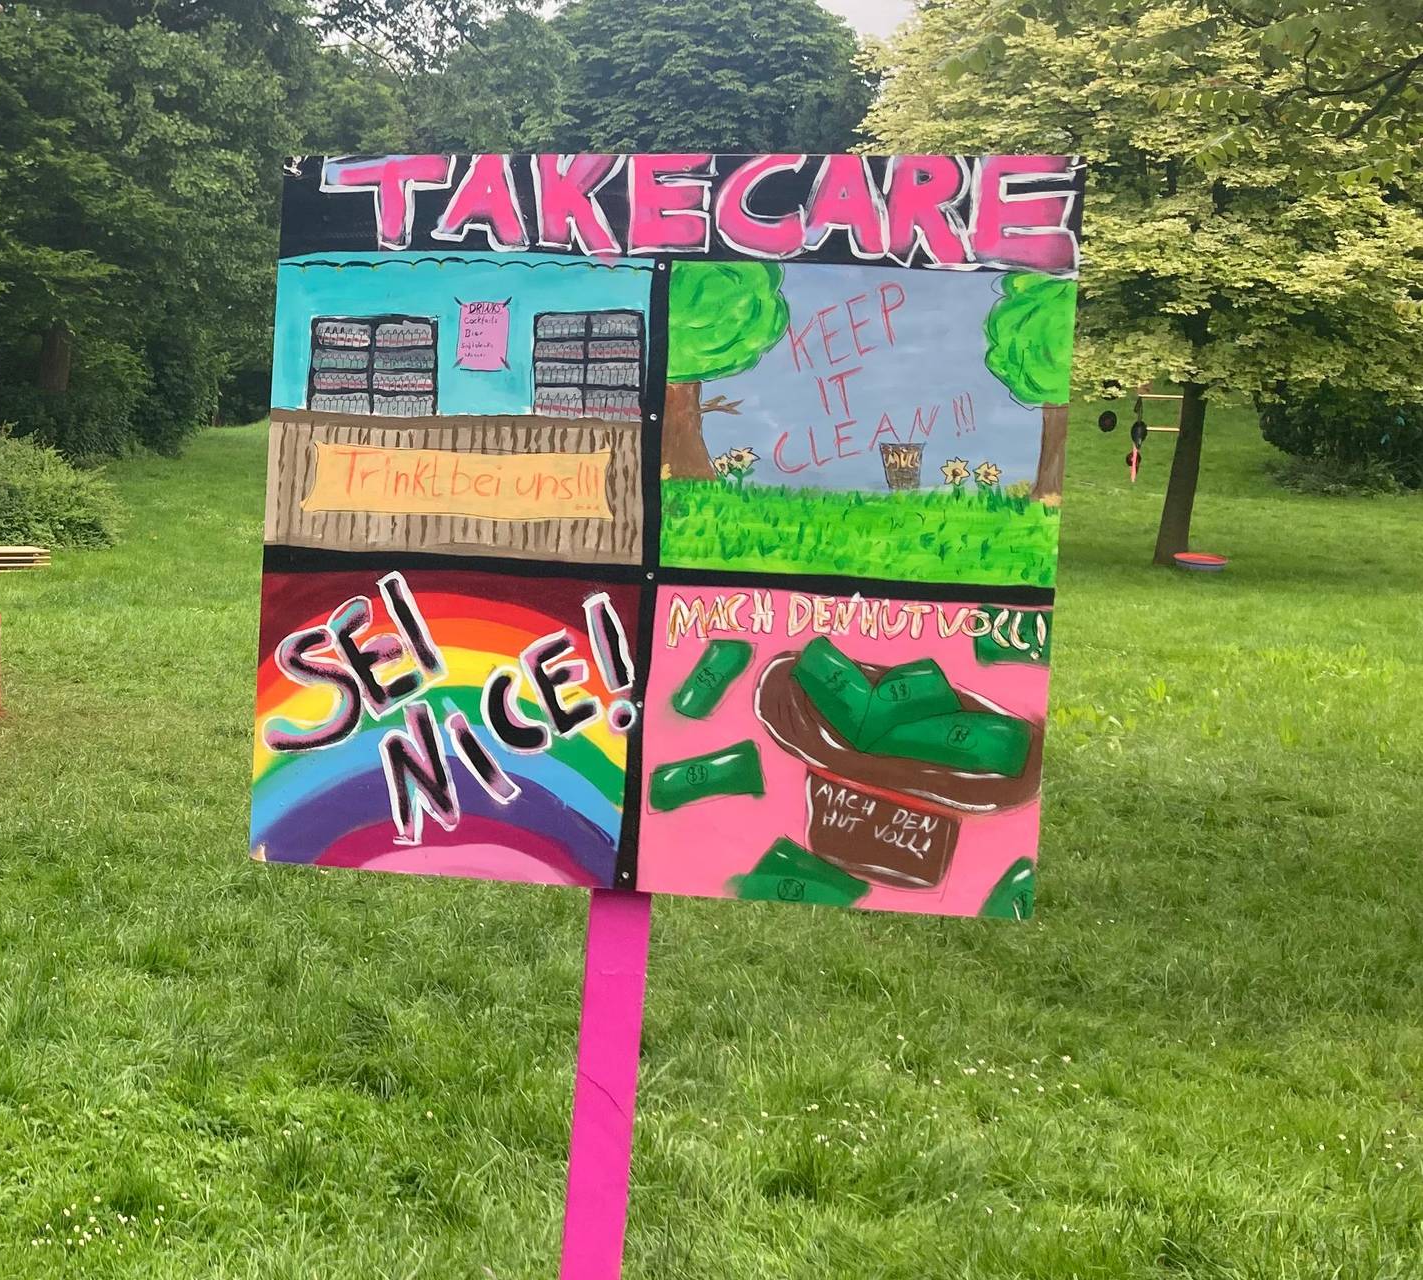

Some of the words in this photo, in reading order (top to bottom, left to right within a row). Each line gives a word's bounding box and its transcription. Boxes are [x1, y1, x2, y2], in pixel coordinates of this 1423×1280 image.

[787, 281, 906, 371] KEEP
[815, 366, 863, 417] IT
[451, 456, 502, 497] bei
[515, 460, 601, 511] uns!!!
[666, 590, 775, 649] MACH
[263, 570, 448, 753] SEI
[377, 591, 637, 846] NICE!
[815, 783, 877, 816] MACH
[892, 808, 939, 833] DEN
[822, 810, 866, 833] HUT
[873, 824, 932, 860] VOLL!
